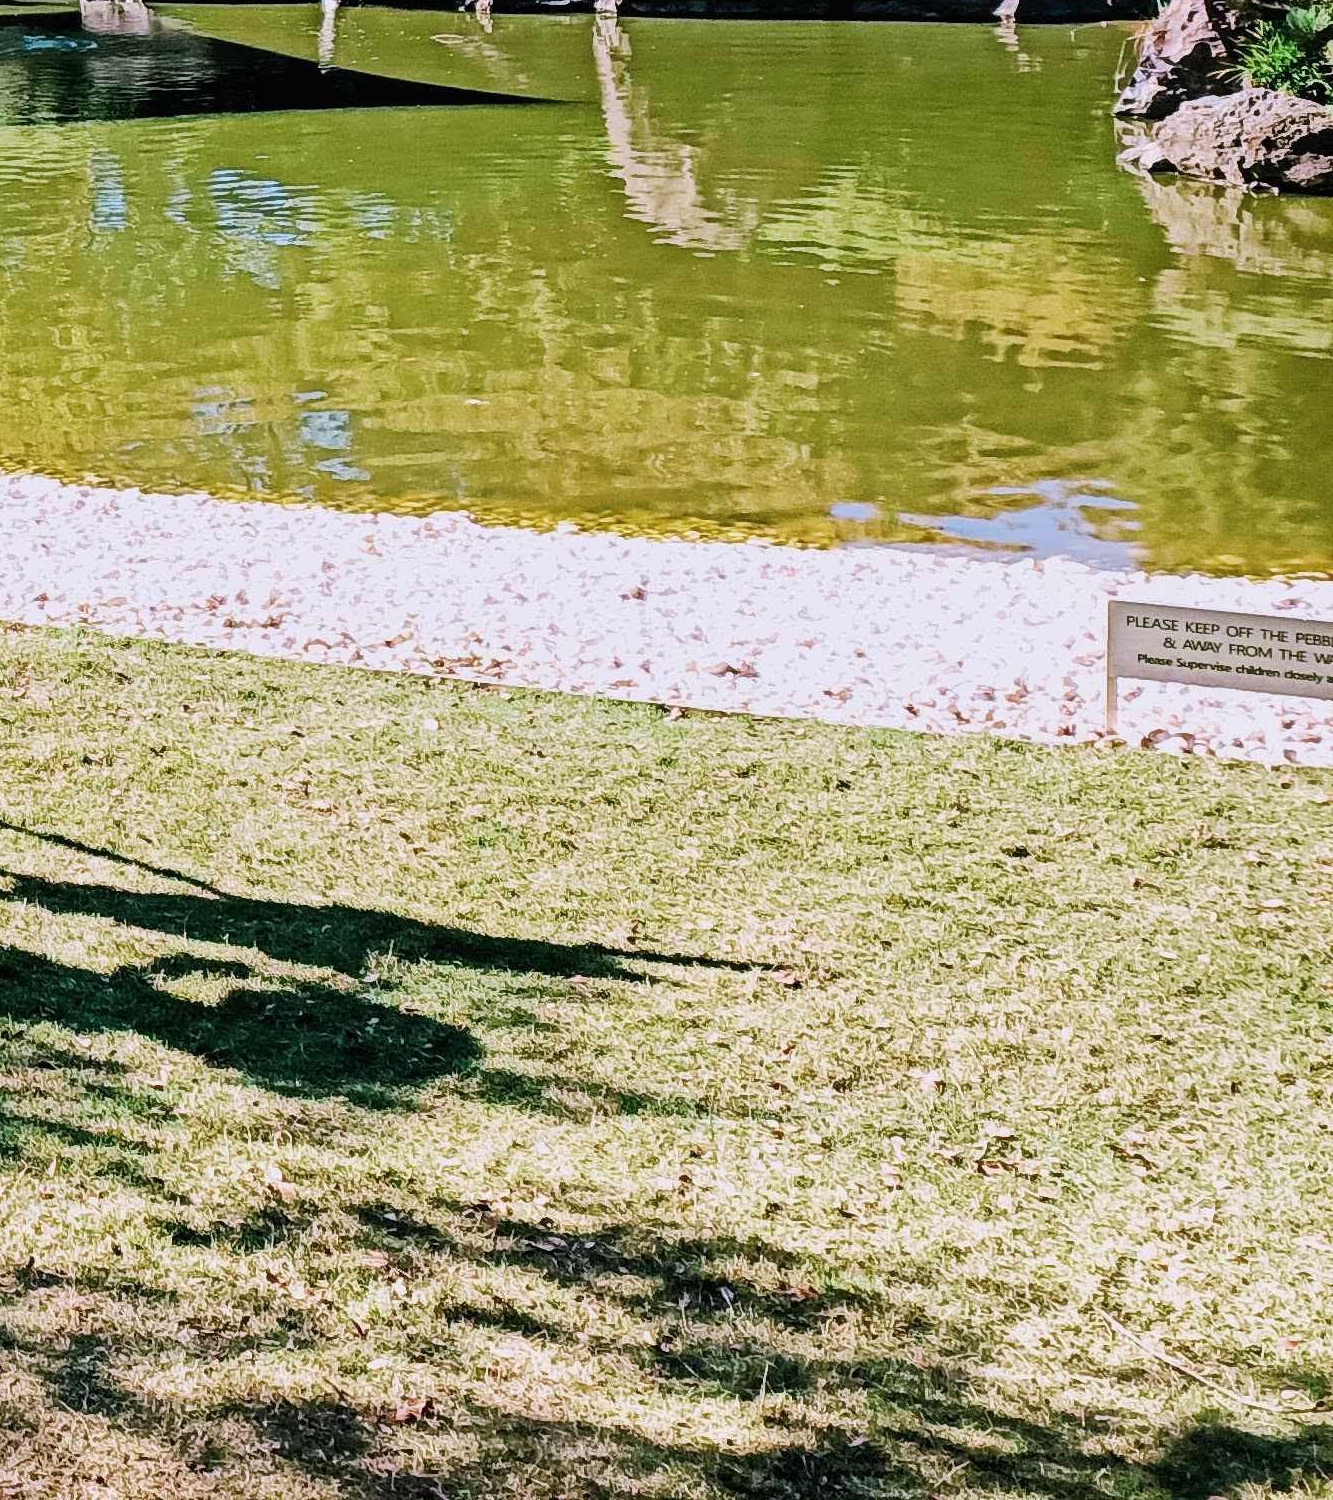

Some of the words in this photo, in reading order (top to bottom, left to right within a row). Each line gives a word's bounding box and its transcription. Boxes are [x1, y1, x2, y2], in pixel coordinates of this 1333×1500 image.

[1126, 615, 1179, 631] PLEASE
[1185, 621, 1220, 635] KEEP
[1226, 625, 1254, 638] OFF
[1260, 629, 1289, 643] THE
[1163, 637, 1177, 649] &
[1183, 639, 1223, 653] AWAY
[1229, 644, 1272, 659] FROM
[1279, 649, 1308, 663] THE
[1137, 653, 1173, 666] Please
[1176, 658, 1232, 672] Supervise
[1236, 665, 1280, 677] children
[1284, 670, 1323, 684] closely
